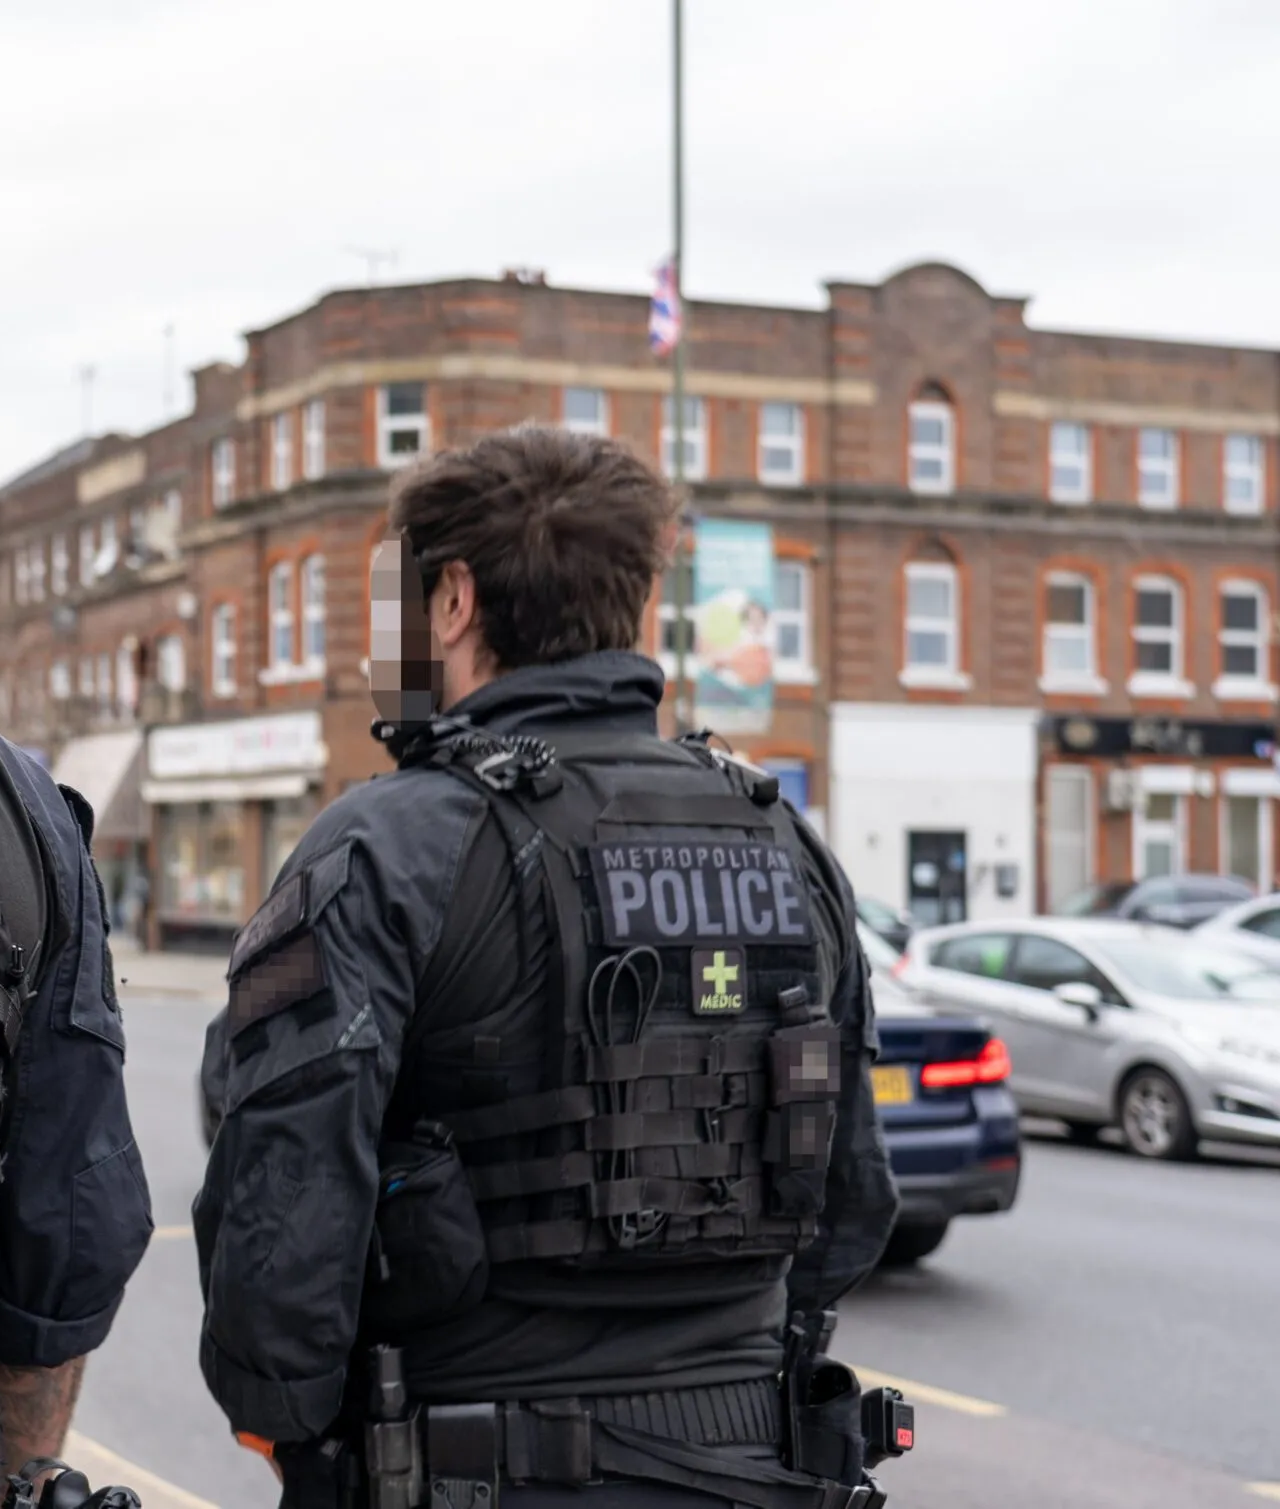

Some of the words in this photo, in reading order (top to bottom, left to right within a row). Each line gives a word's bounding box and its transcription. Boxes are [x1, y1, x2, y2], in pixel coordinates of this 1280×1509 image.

[602, 846, 791, 870] METROPOLITAN
[606, 869, 805, 937] POLICE
[699, 993, 742, 1010] MEDIC
